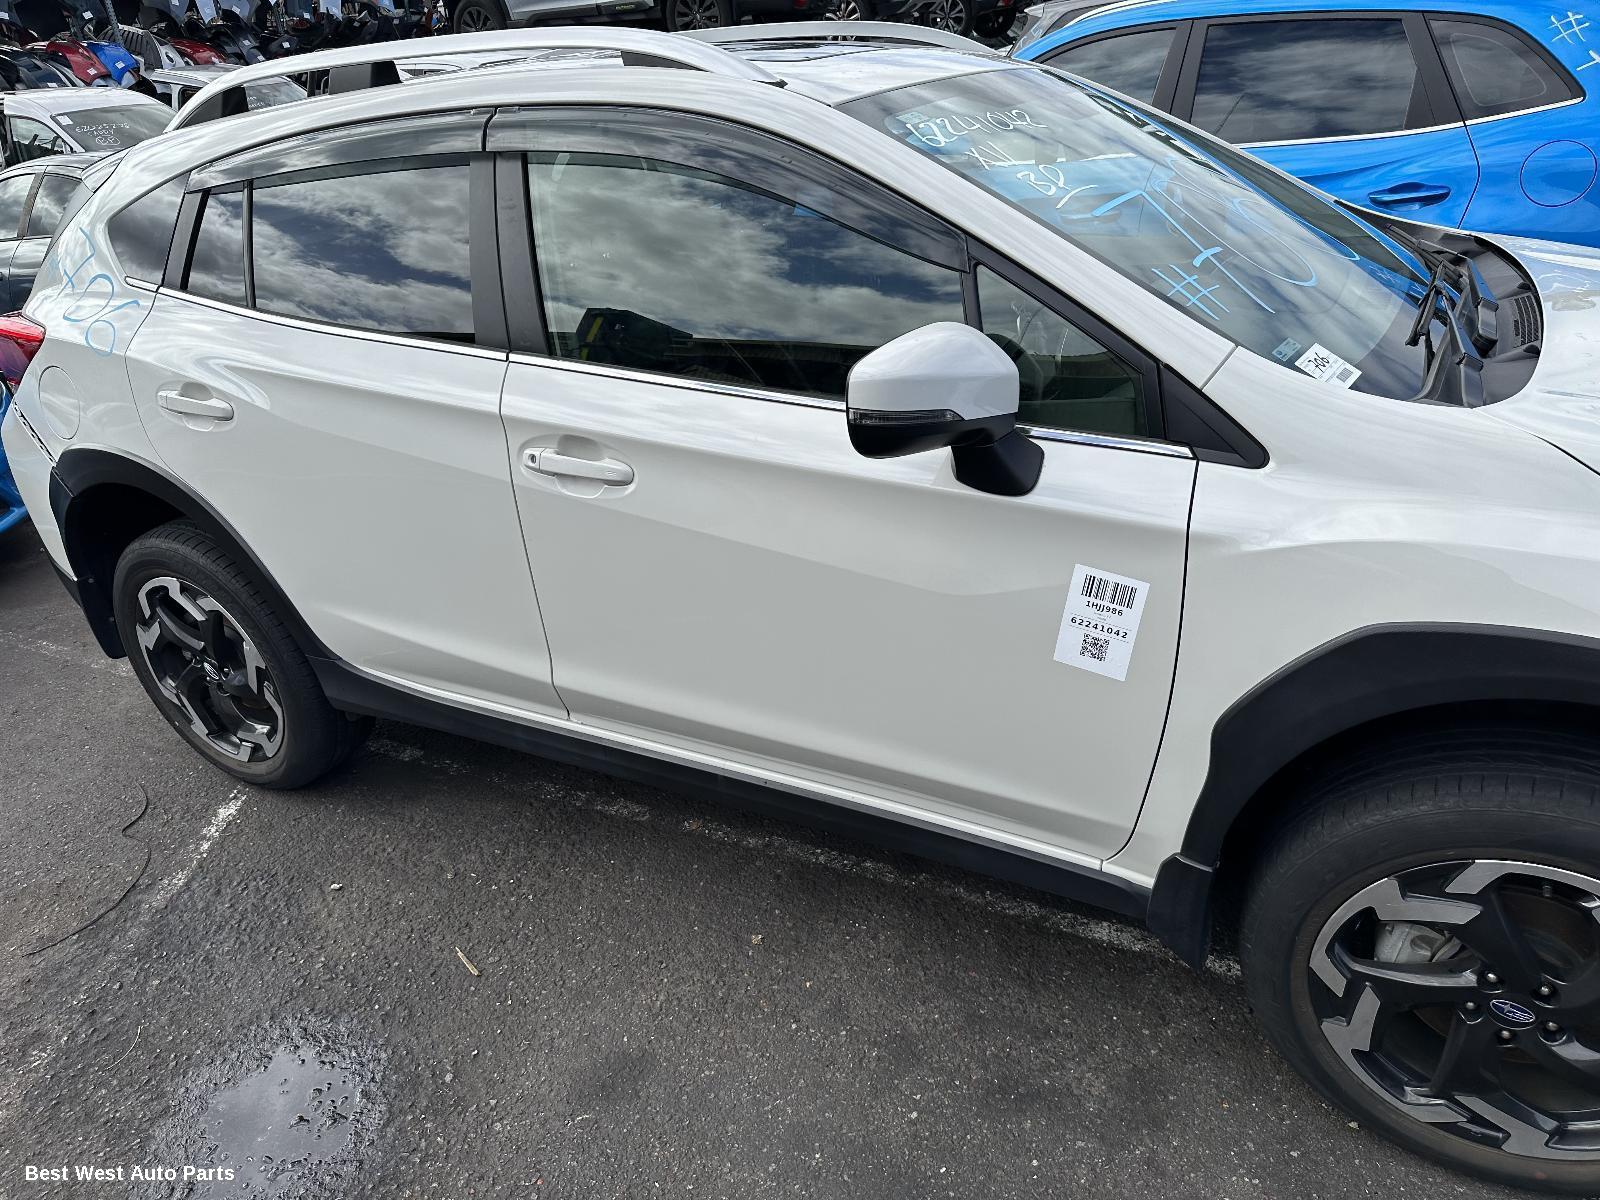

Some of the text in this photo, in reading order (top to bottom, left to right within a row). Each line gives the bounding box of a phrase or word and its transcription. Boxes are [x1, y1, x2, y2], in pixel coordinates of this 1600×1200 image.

[906, 109, 1048, 147] 62241042
[1085, 600, 1124, 617] 1HJJ986
[1070, 616, 1129, 640] 62241042
